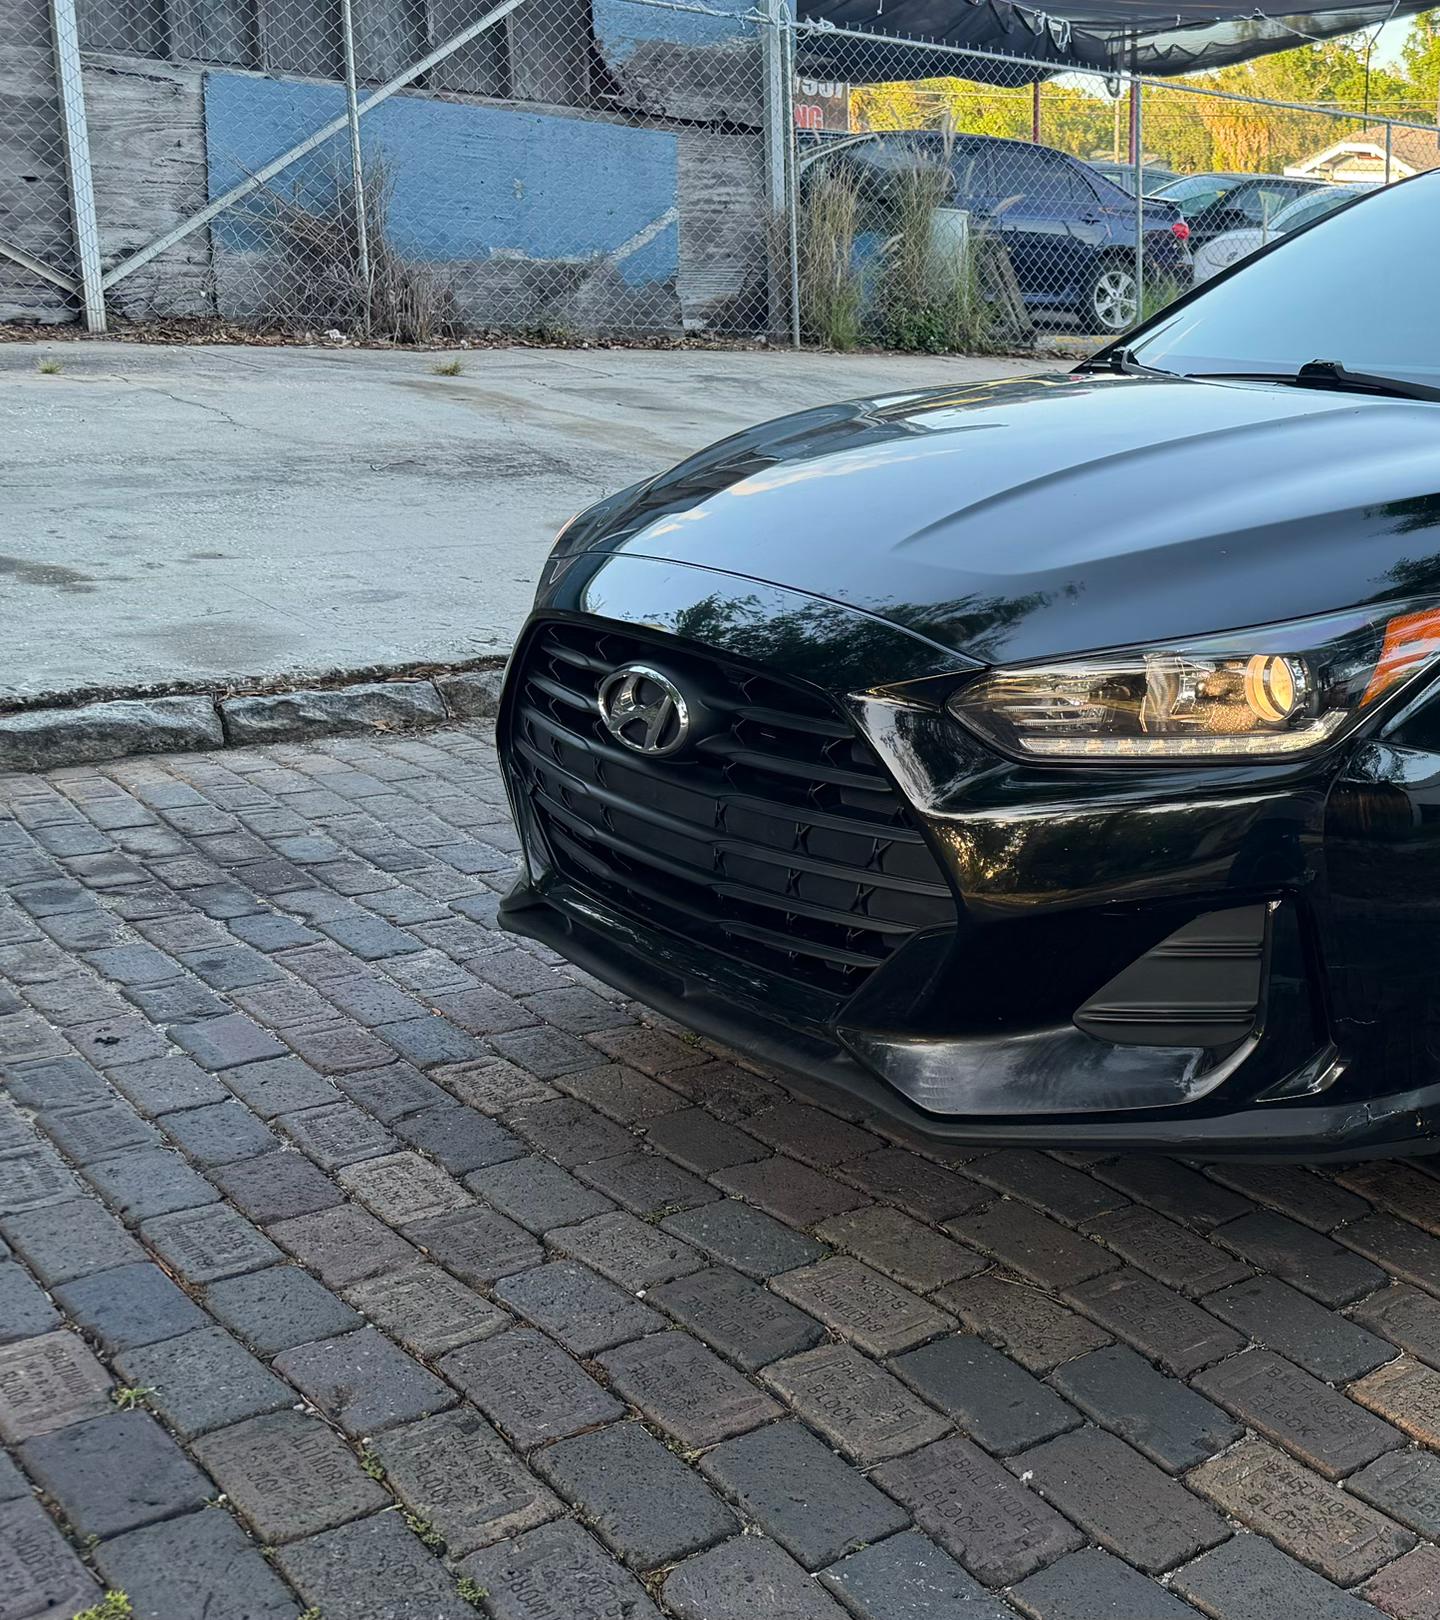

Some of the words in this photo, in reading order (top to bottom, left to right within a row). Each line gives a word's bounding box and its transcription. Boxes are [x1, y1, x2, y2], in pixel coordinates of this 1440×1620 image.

[851, 1276, 911, 1310] BLOCK
[802, 1383, 863, 1426] BLOCK
[283, 1432, 355, 1491] ALTIMORE
[919, 1487, 987, 1539] BLOCK
[949, 1457, 1046, 1532] BALTIMORE
